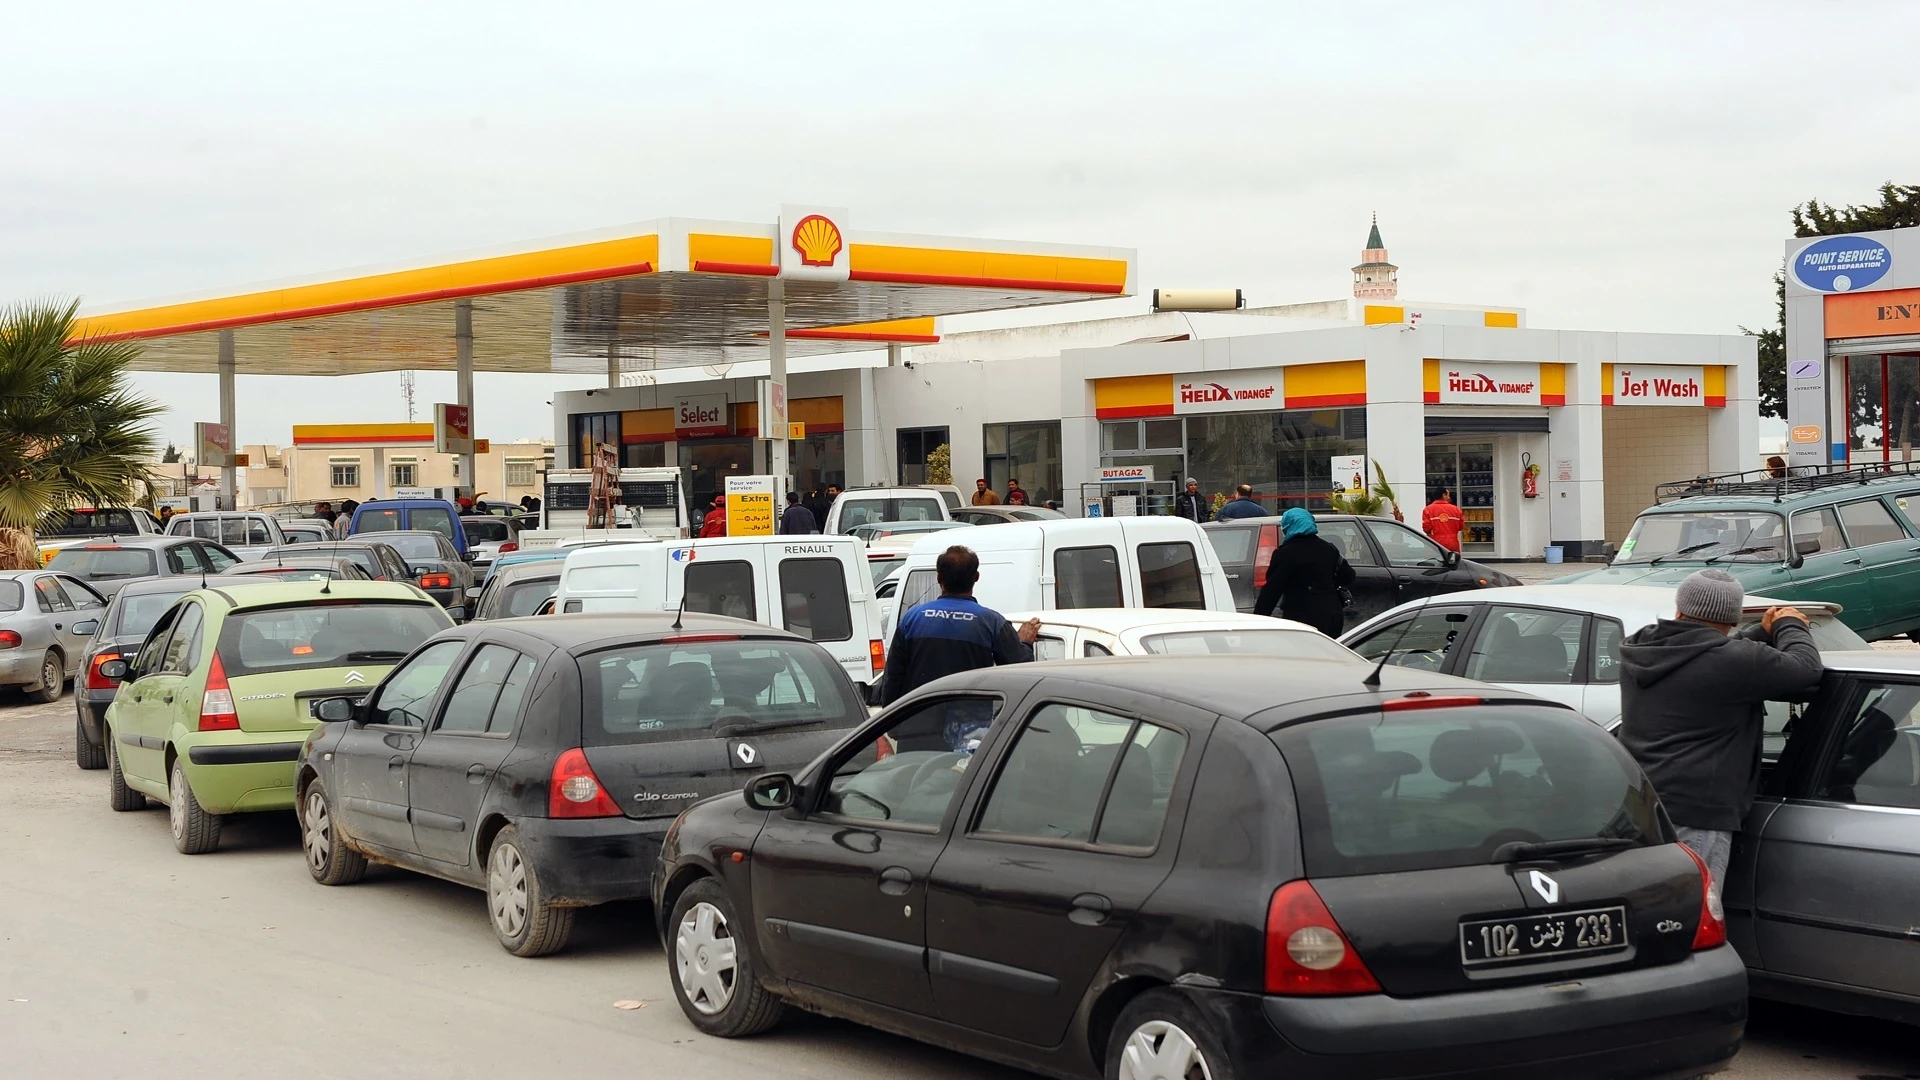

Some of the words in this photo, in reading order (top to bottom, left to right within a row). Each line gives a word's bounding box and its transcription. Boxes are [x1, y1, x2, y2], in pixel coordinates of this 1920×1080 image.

[1803, 251, 1838, 266] POINT
[1837, 248, 1885, 263] SERVICE
[1817, 264, 1837, 272] AUTO
[1837, 261, 1881, 270] REPARATION
[1448, 373, 1498, 393] HELIX
[1621, 376, 1649, 397] Jet
[1653, 377, 1699, 398] Wash
[1181, 384, 1233, 404] HELIX
[680, 405, 720, 424] Select
[793, 426, 799, 436] 1
[479, 442, 486, 450] 3
[1102, 469, 1144, 478] BUTAGAZ
[741, 495, 770, 503] Extra
[784, 545, 834, 554] RENAULT
[681, 550, 689, 561] F
[924, 609, 974, 621] DAYCO
[1480, 924, 1520, 957] 102
[1529, 916, 1565, 948] تونس
[1575, 913, 1613, 946] 233
